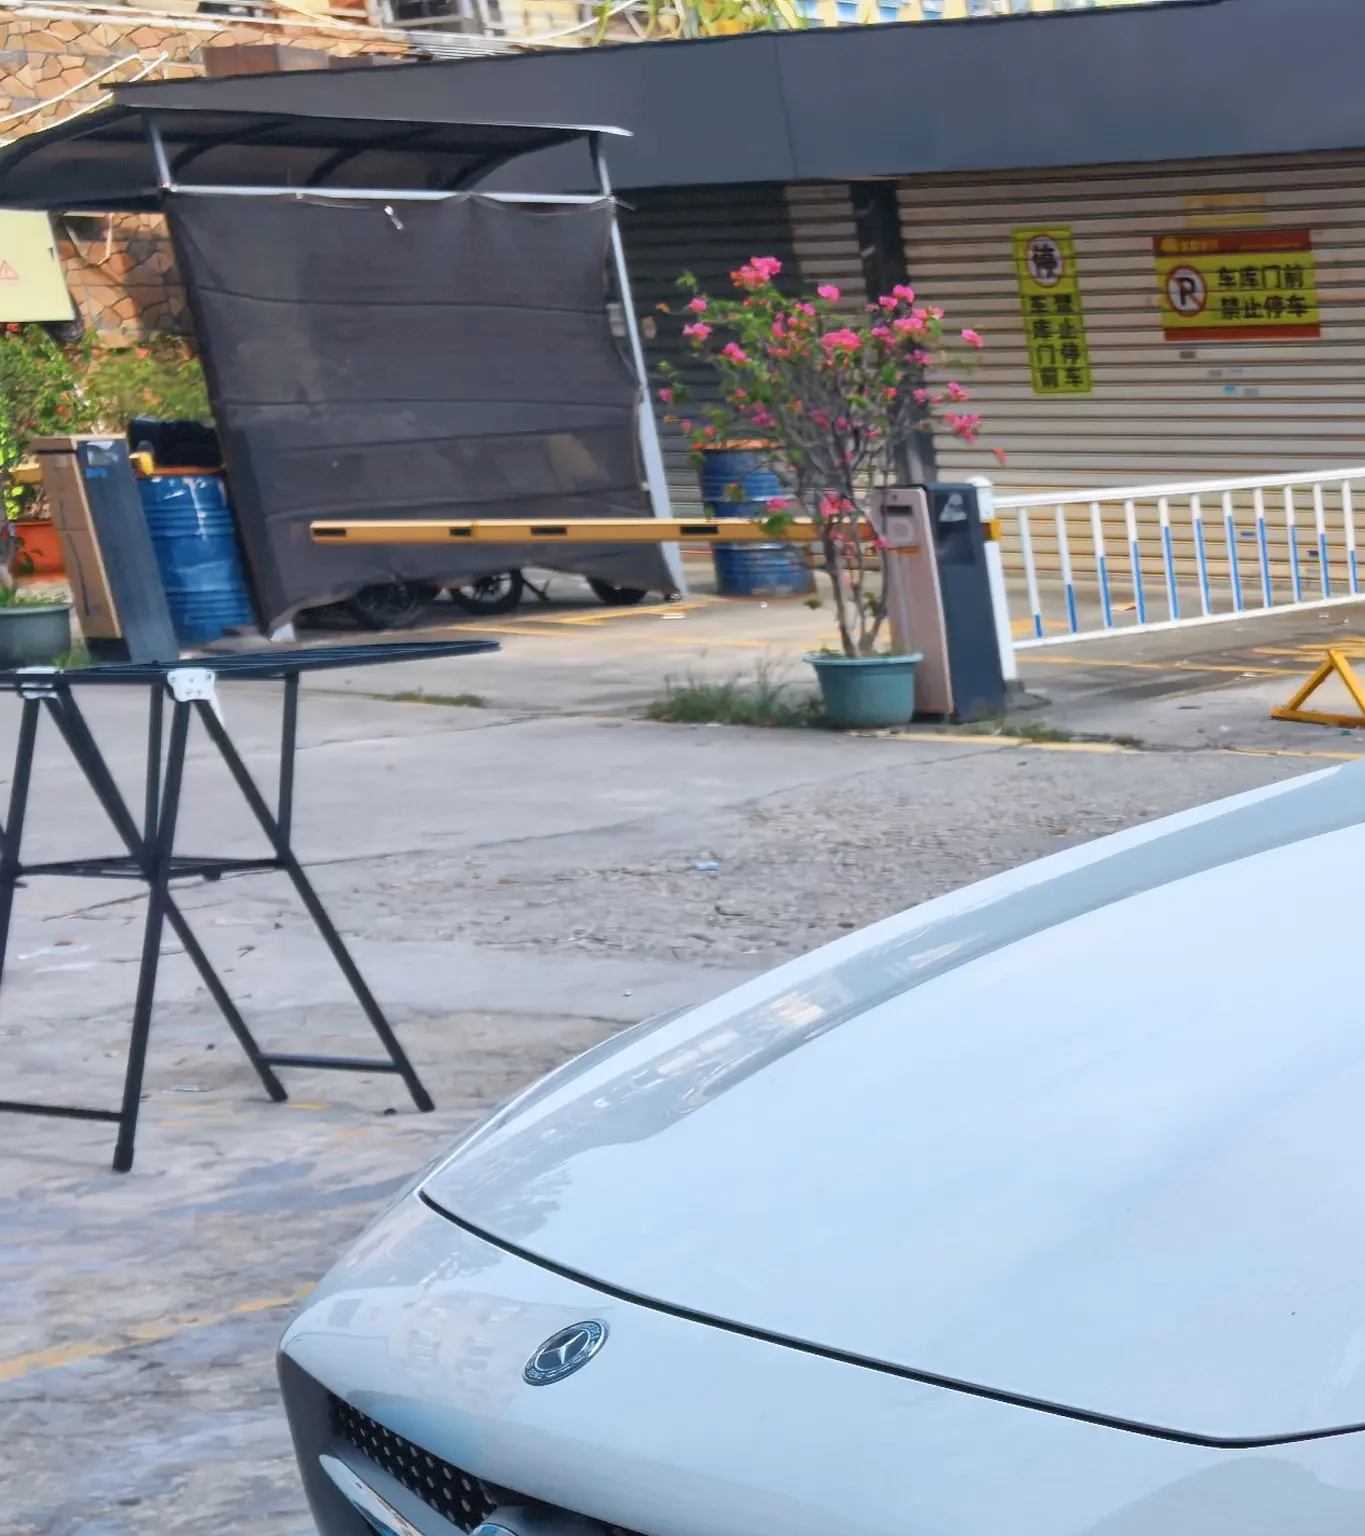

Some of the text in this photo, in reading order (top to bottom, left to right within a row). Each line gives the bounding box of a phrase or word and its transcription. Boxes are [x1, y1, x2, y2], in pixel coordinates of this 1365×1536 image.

[1217, 264, 1303, 289] 车库门前
[1220, 294, 1309, 319] 禁止停车
